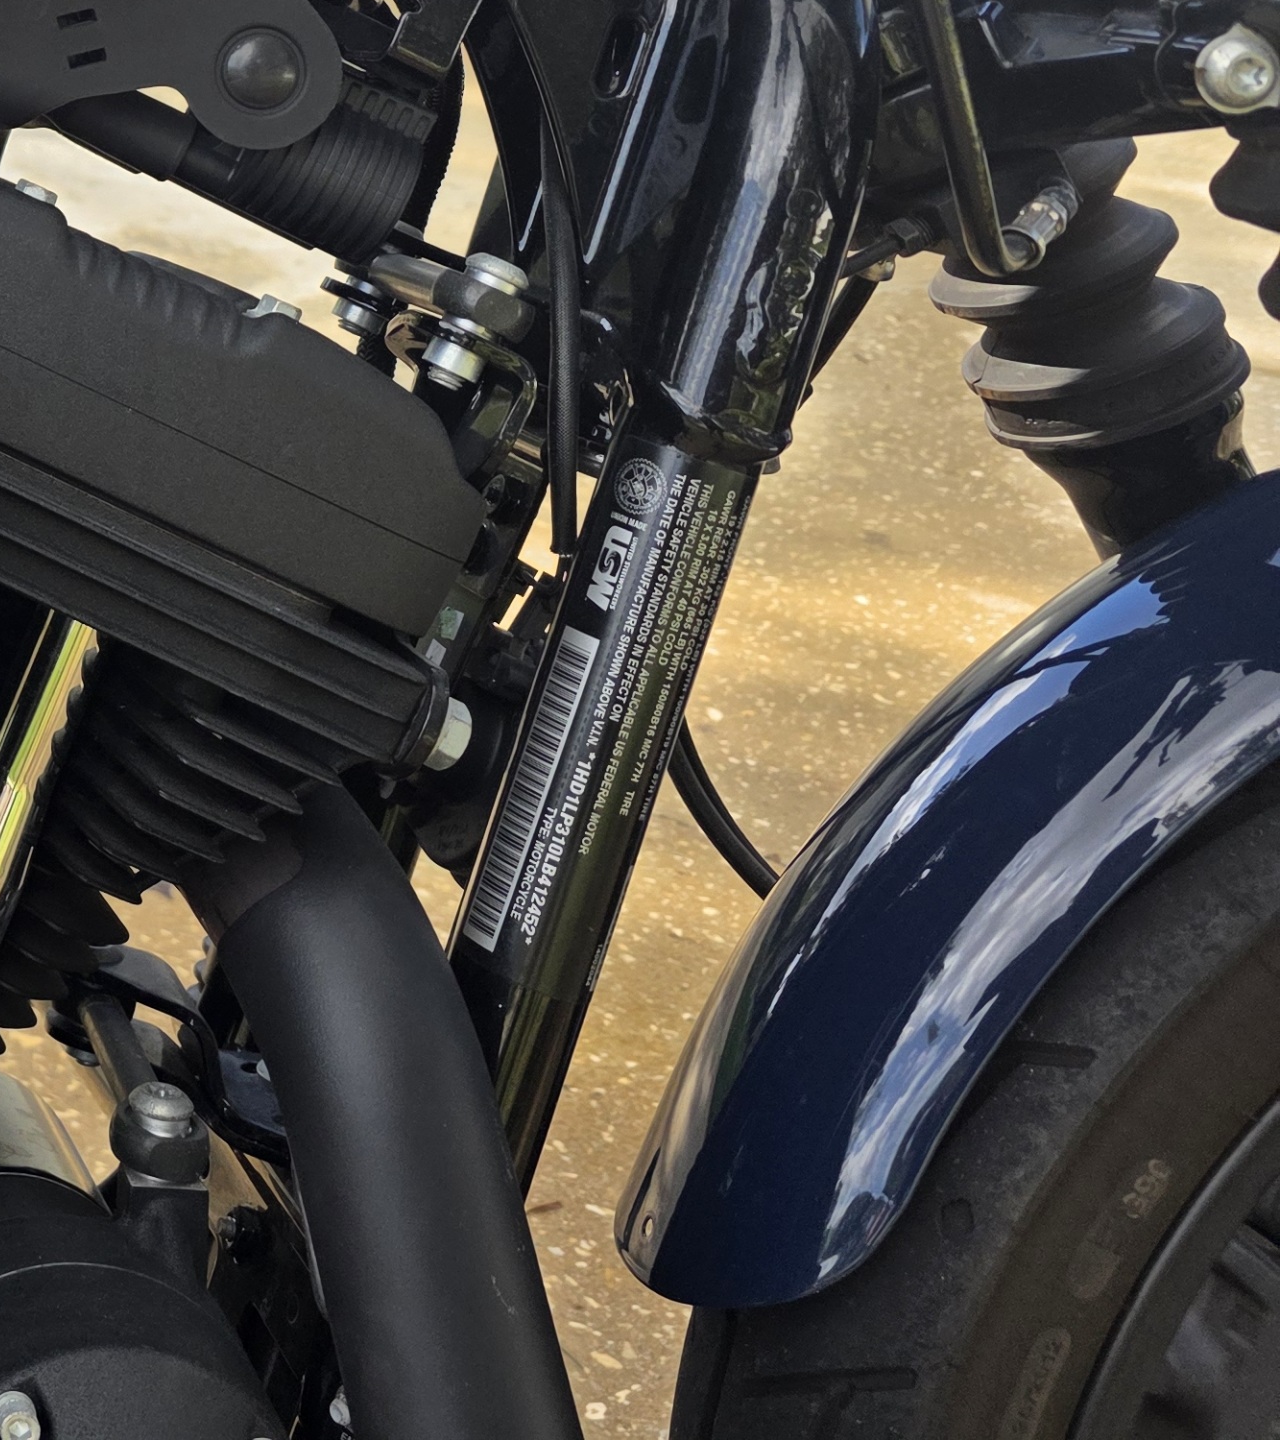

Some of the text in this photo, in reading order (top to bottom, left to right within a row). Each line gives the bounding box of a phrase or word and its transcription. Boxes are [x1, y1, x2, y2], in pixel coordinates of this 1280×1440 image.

[669, 473, 686, 497] THE
[658, 496, 678, 529] DATE
[717, 489, 736, 525] GAWR
[723, 527, 732, 537] X
[727, 515, 737, 527] 19
[653, 528, 666, 547] OF
[706, 526, 724, 558] REAR
[586, 525, 632, 610] USW
[609, 535, 639, 610] UNITED STEELWORKERS
[697, 565, 710, 586] 302
[708, 562, 721, 584] RIM
[608, 478, 701, 722] VEHICLE SAFETY STANDARDS IN EFFECT ON
[622, 546, 660, 633] MANUFACTURE
[657, 509, 718, 666] 16 X 3.00 RIM AT 40 PSI COLD
[691, 586, 704, 605] KG
[702, 584, 713, 601] AT
[682, 605, 696, 629] (665
[697, 602, 708, 616] 30
[673, 630, 689, 650] LB)
[690, 617, 702, 637] PSI
[607, 633, 630, 678] SHOWN
[665, 651, 682, 681] WITH
[679, 637, 695, 671] COLD
[577, 483, 714, 855] THIS VEHICLE CONFORMS TO ALL APPLICABLE US FEDERAL MOTOR
[593, 677, 615, 719] ABOVE
[646, 683, 671, 736] 150/80B16
[585, 719, 605, 746] V.I.N.
[638, 737, 652, 759] M/C
[630, 761, 645, 783] 77H
[618, 790, 635, 816] TIRE
[510, 806, 558, 920] TYPE: MOTORCYCLE
